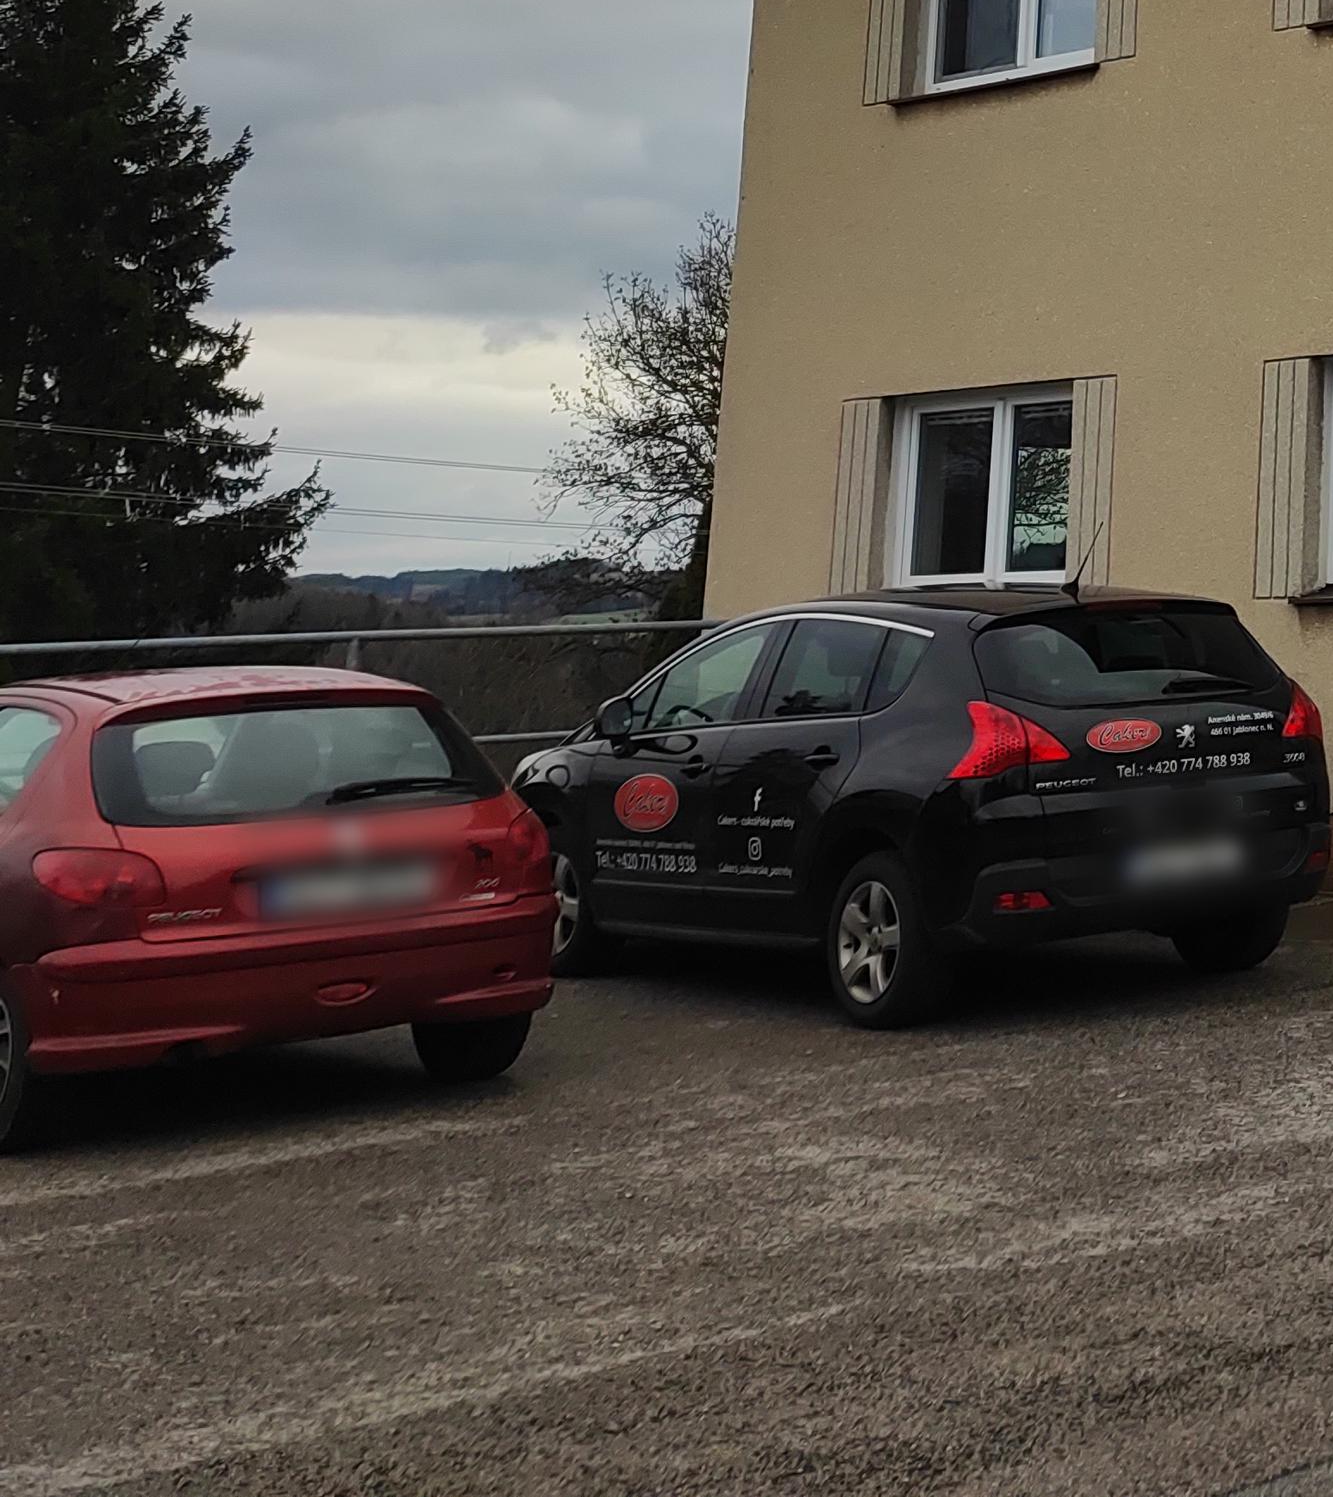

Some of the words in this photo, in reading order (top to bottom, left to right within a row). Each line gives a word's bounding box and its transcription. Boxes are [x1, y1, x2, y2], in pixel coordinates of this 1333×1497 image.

[1210, 727, 1223, 735] 466
[1223, 726, 1231, 734] 01
[1232, 725, 1259, 735] Jablonec
[1116, 765, 1144, 779] Tel.:
[1146, 760, 1177, 775] +420
[1180, 756, 1203, 771] 774
[1205, 754, 1227, 768] 788
[1230, 752, 1250, 766] 938
[1035, 778, 1097, 789] PEUGEOT
[616, 852, 638, 870] +420
[639, 853, 657, 871] 774
[658, 854, 677, 872] 788
[677, 855, 697, 873] 938
[147, 908, 223, 923] PEUGEOT
